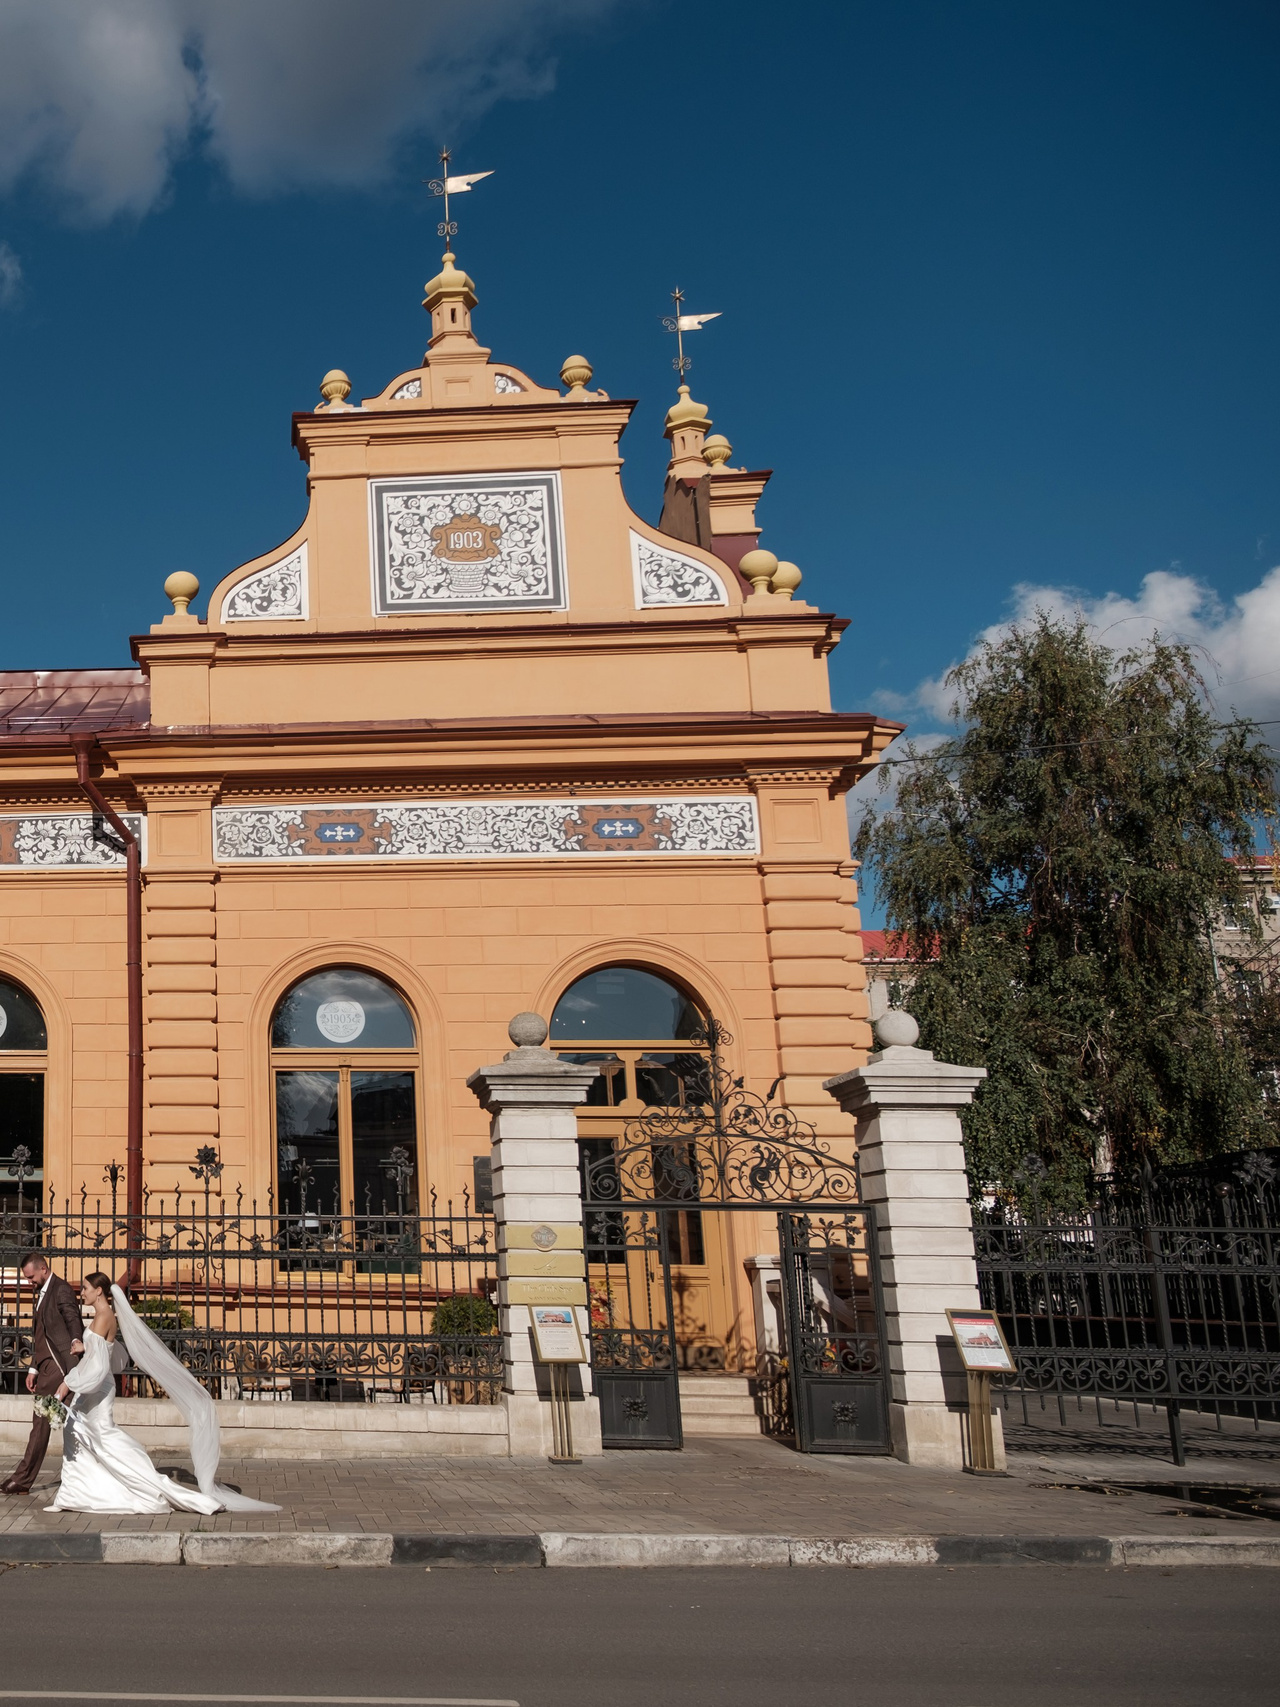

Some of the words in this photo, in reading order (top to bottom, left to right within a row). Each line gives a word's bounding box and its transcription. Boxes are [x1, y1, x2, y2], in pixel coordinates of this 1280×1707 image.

[450, 530, 482, 549] 1903
[330, 1013, 352, 1024] 1903
[521, 1283, 538, 1292] The
